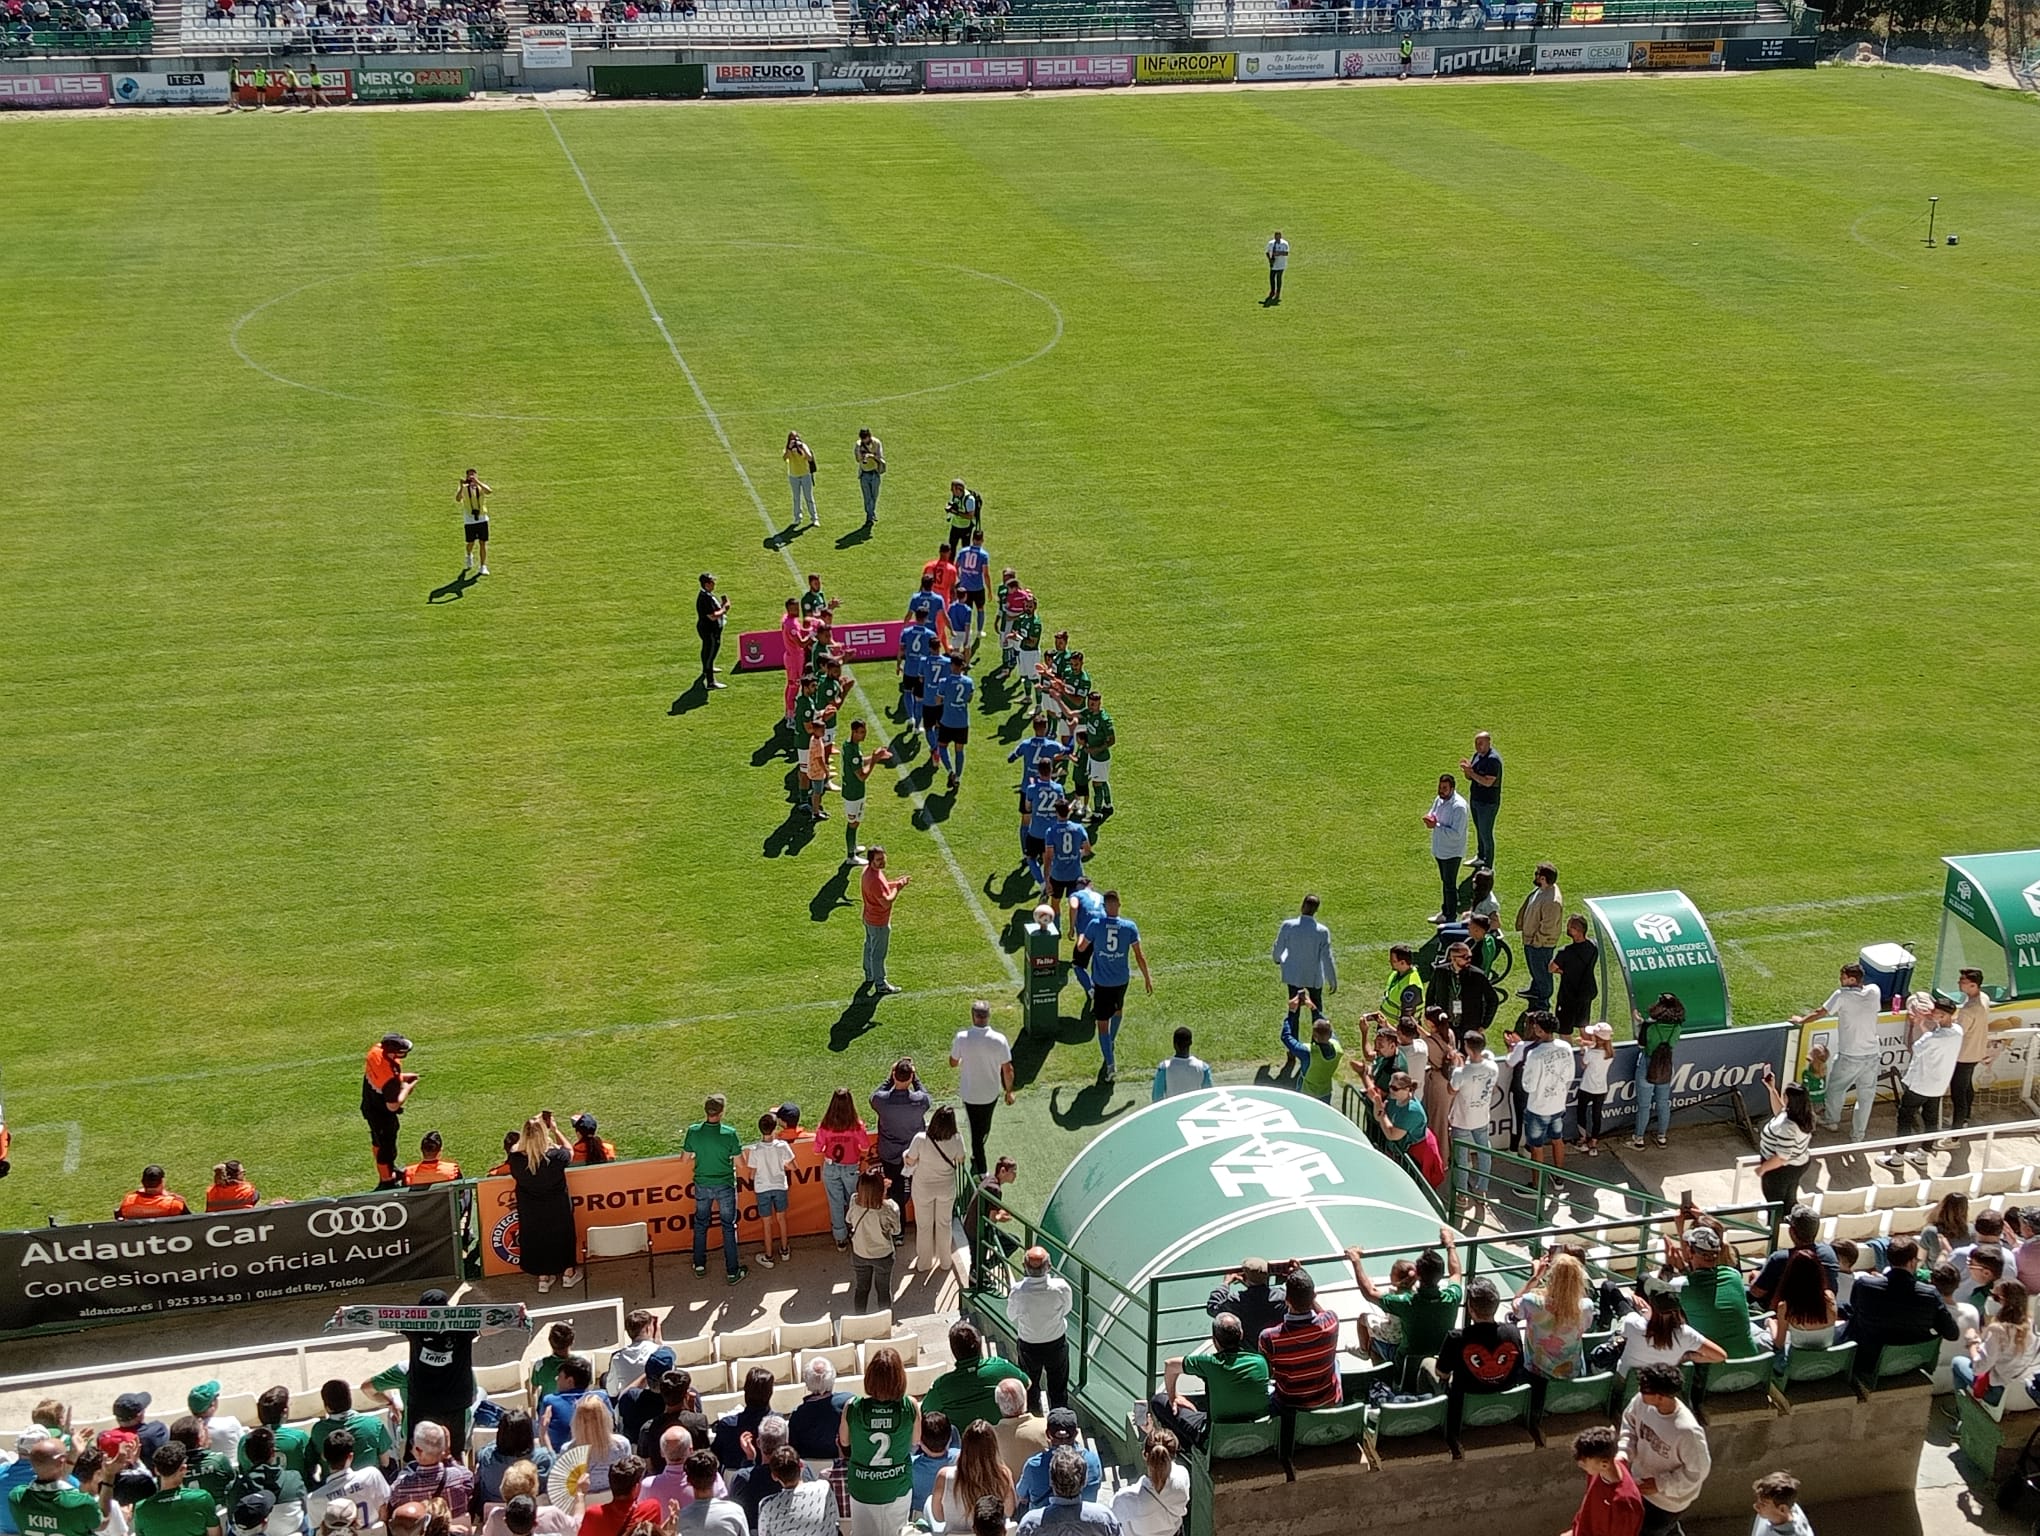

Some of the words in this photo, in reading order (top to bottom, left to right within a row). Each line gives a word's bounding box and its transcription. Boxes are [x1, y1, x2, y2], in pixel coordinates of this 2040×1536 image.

[1440, 45, 1520, 73] ROTULO
[1541, 48, 1583, 58] EXPANET
[717, 65, 804, 78] IBERFURGO
[930, 60, 1024, 78] SOLISS
[1037, 59, 1128, 75] SOLISS
[0, 77, 103, 95] SOLISS
[169, 74, 204, 85] ITSA
[965, 551, 978, 569] 10
[845, 629, 886, 646] ISS
[911, 634, 921, 652] 6
[932, 665, 942, 683] 7
[955, 683, 965, 703] 2
[1037, 790, 1058, 812] 22
[1062, 832, 1073, 854] 8
[1106, 928, 1119, 952] 5
[1630, 950, 1716, 972] ALBARREAL
[571, 1177, 754, 1212] PROTECCN
[20, 1235, 193, 1267] Aldauto
[205, 1224, 275, 1248] Car
[24, 1261, 238, 1298] Concesionario
[247, 1247, 339, 1275] oficial
[344, 1238, 411, 1263] Audi
[79, 1302, 153, 1318] aldautocar.es
[167, 1297, 190, 1308] 925
[191, 1295, 206, 1306] 35
[208, 1294, 225, 1304] 34
[226, 1293, 242, 1303] 30
[285, 1285, 302, 1295] del
[304, 1283, 327, 1294] Rey,
[329, 1278, 365, 1289] Toledo
[444, 1308, 457, 1319] 90
[440, 1320, 447, 1329] A
[448, 1319, 481, 1330] TOLEDO
[868, 1432, 893, 1467] 2
[855, 1464, 906, 1480] INFORCOPY
[28, 1514, 58, 1530] KIRI
